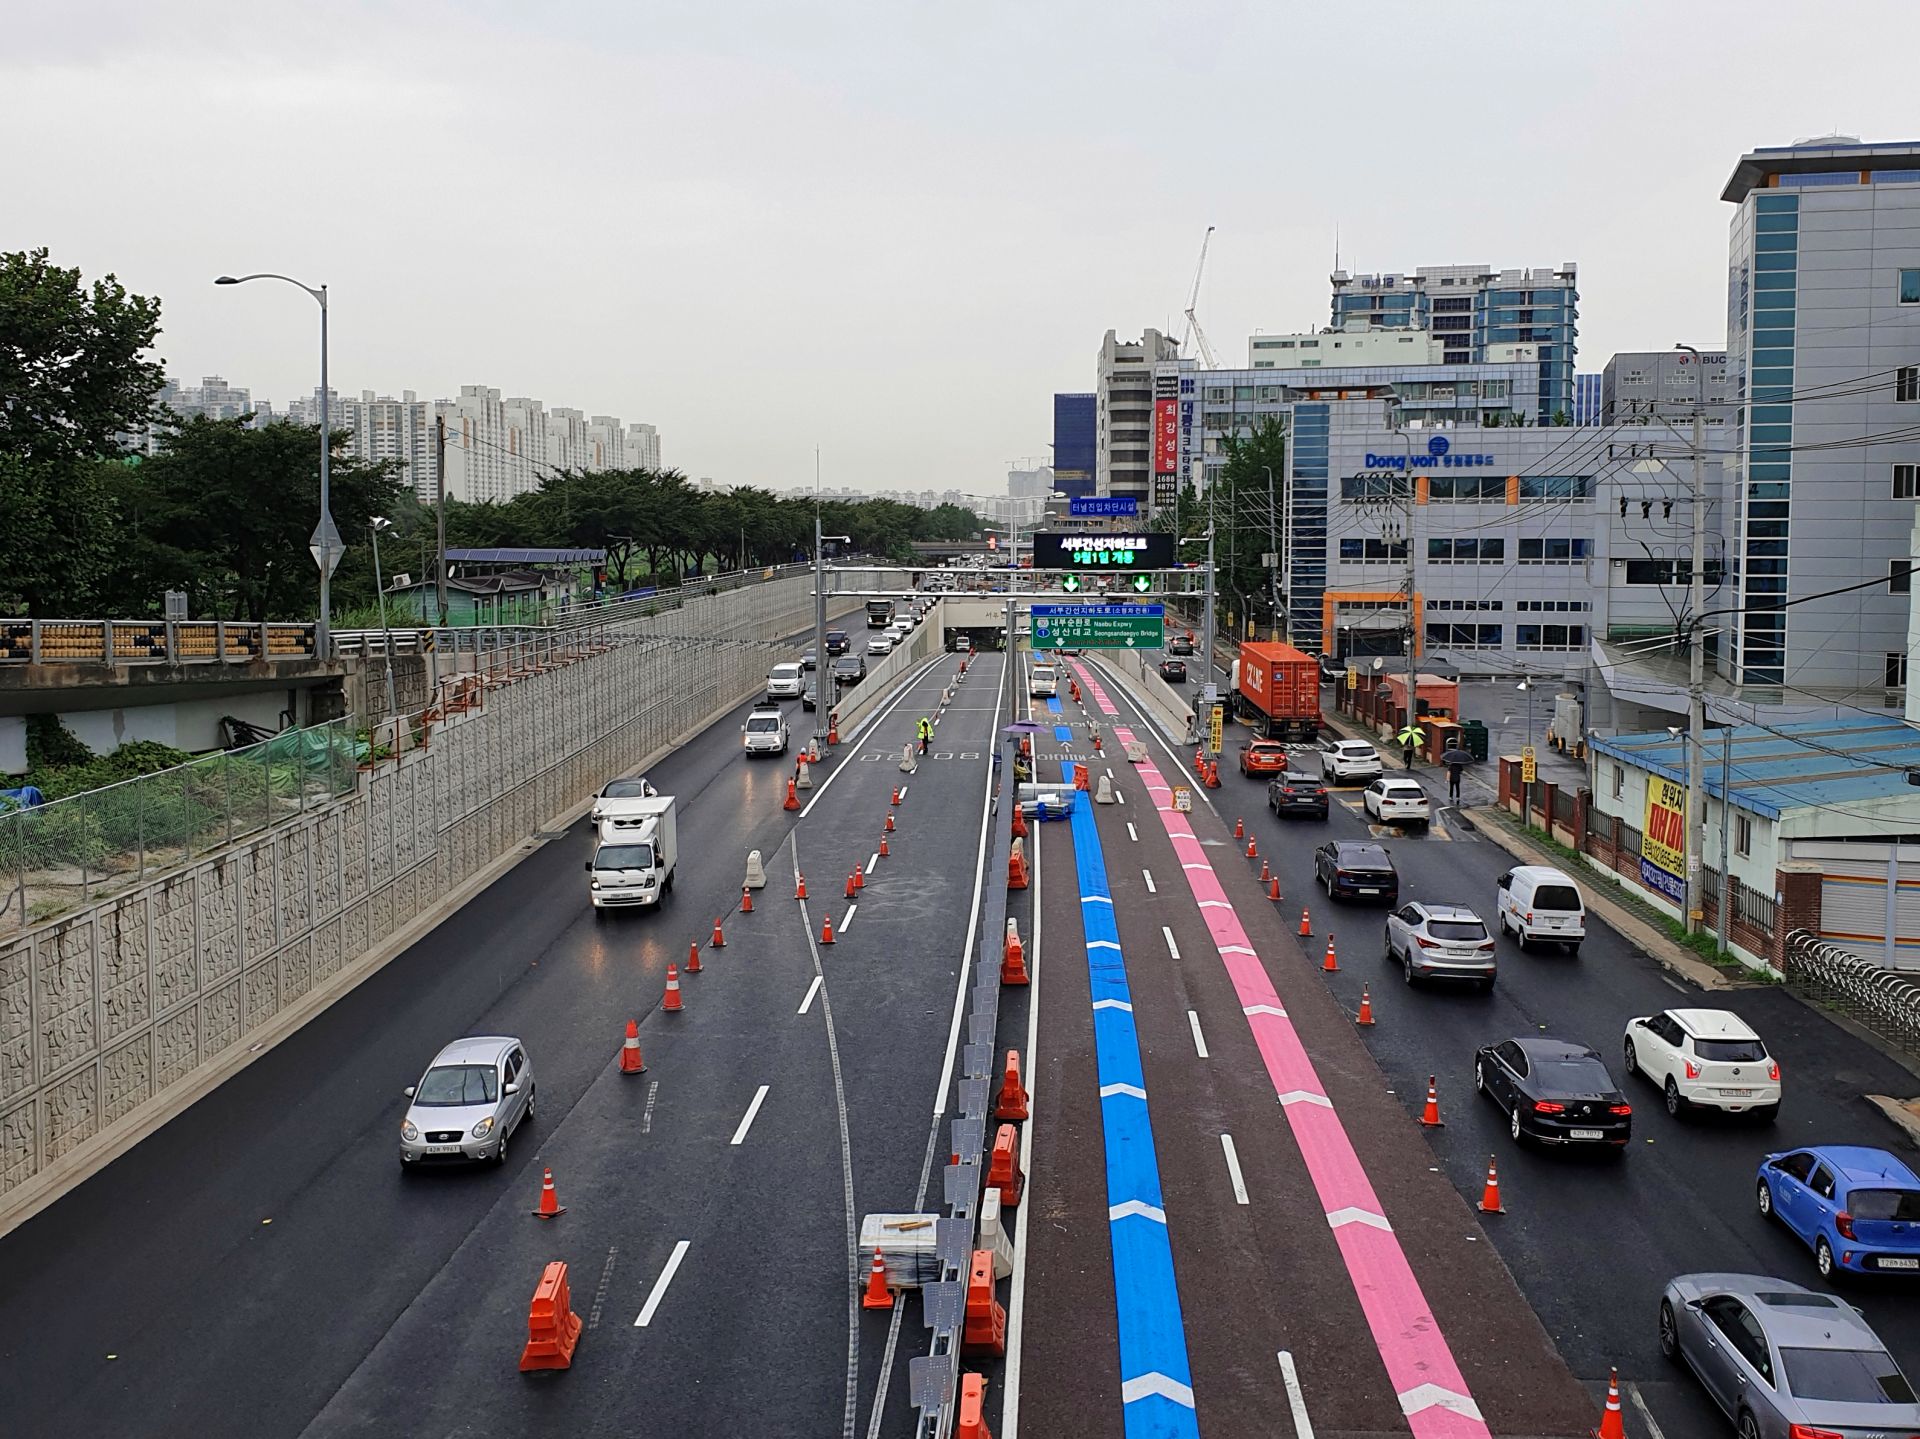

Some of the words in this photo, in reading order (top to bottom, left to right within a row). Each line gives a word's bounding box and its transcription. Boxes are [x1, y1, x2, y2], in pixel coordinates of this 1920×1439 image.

[1072, 502, 1135, 512] 터널진입차단시설
[1052, 628, 1092, 637] 성산대교
[1140, 630, 1159, 638] Bridge
